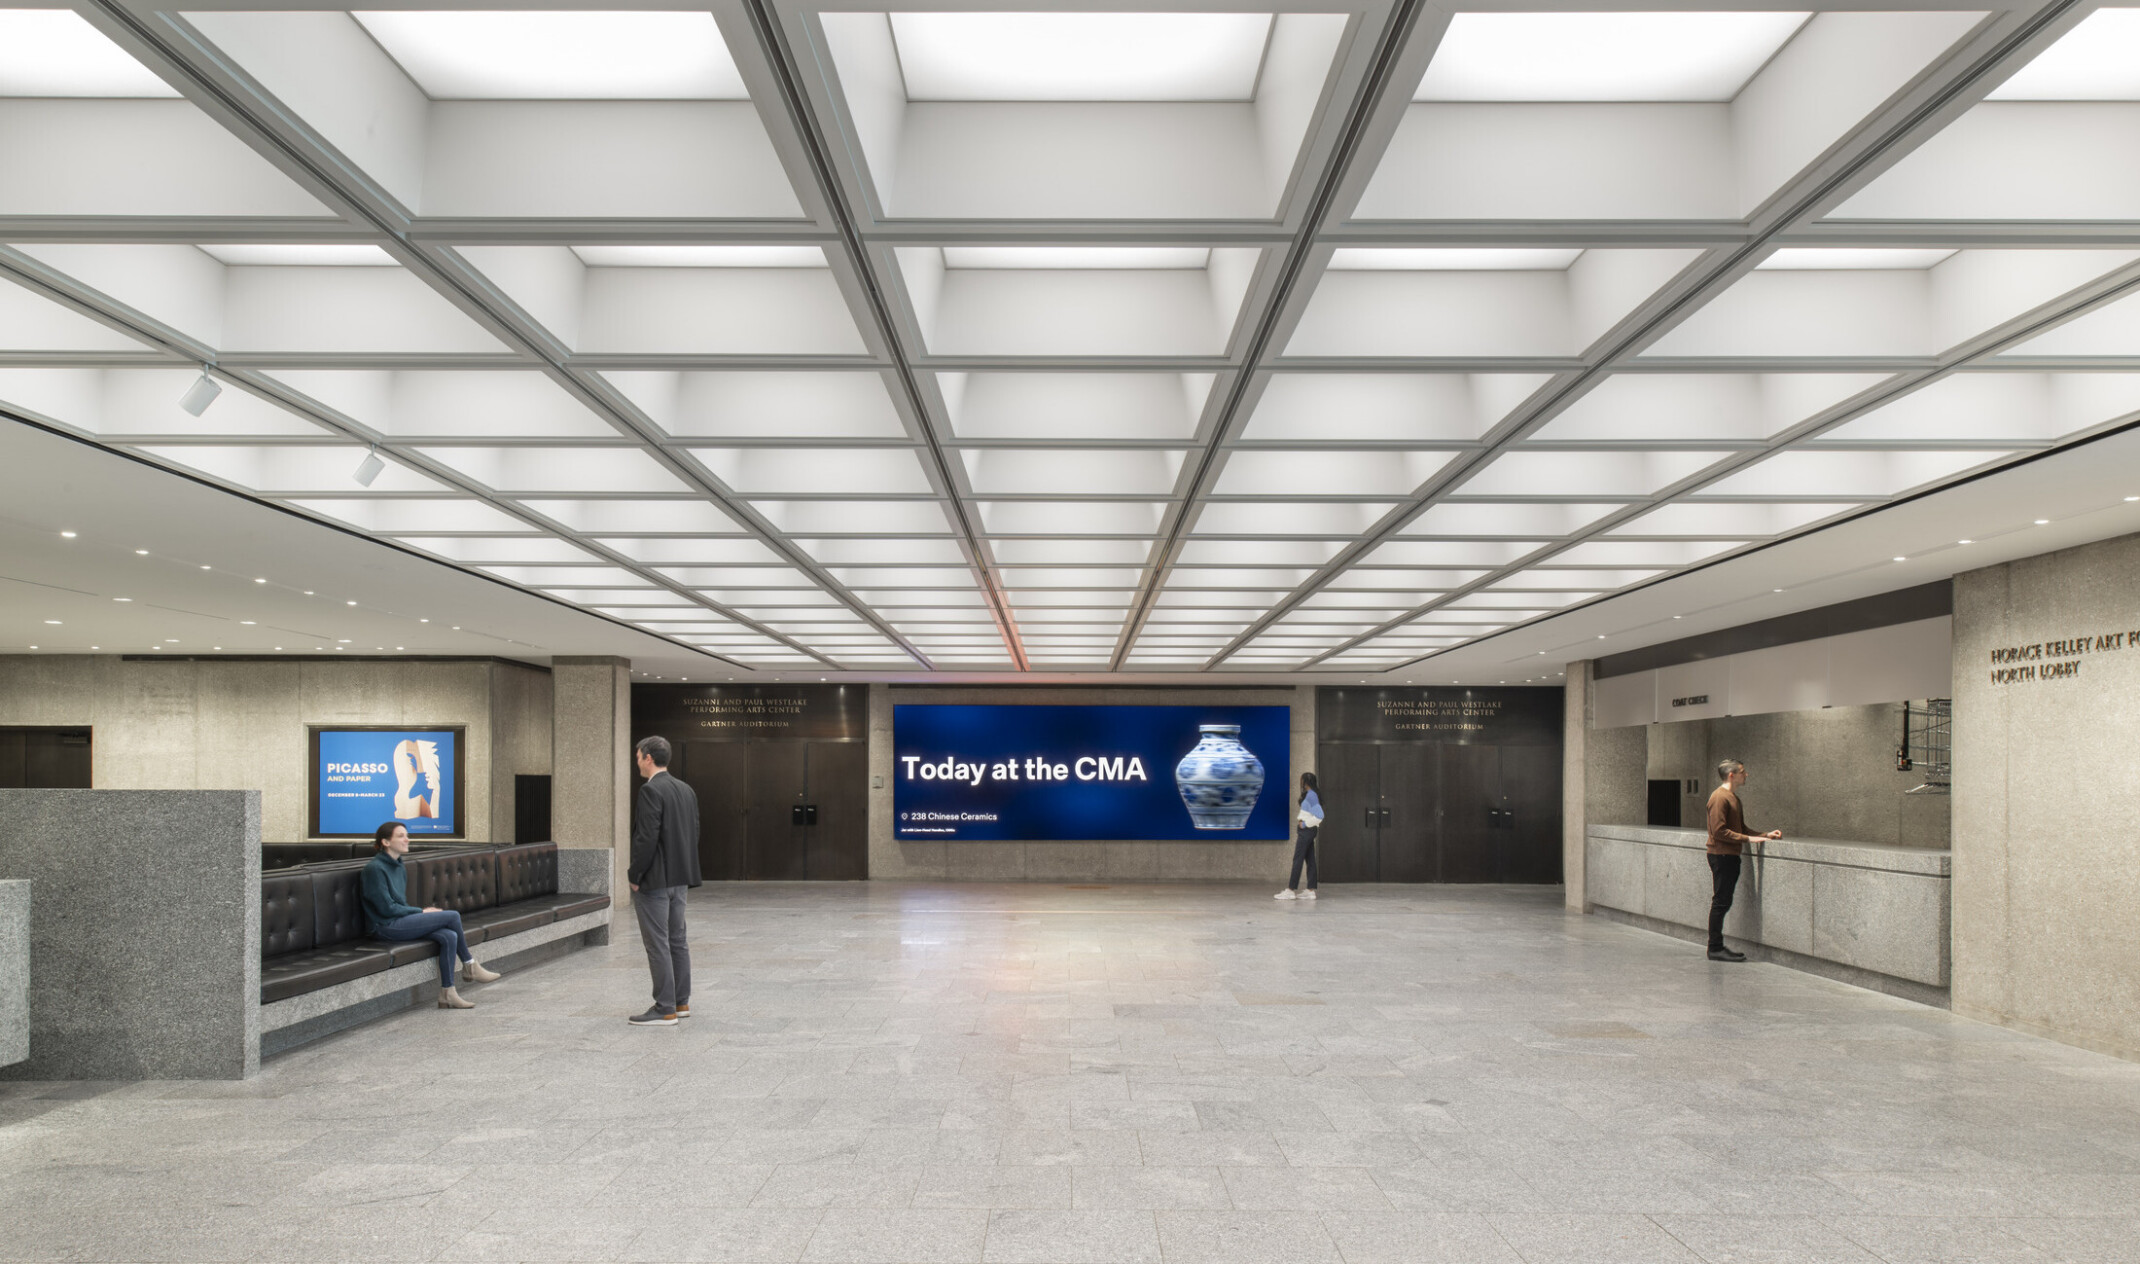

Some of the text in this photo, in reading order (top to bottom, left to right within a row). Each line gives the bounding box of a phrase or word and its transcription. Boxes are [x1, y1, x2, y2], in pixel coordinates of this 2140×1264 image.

[1991, 644, 2041, 663] HORACE
[2045, 637, 2092, 655] KELLEY
[2095, 632, 2124, 649] ART
[1991, 661, 2081, 684] NORTH LOBBY
[1461, 701, 1502, 709] WESTLAKE
[1672, 695, 1709, 707] COAT CHECK
[1385, 708, 1495, 716] PERFORMING ARTS CENTER
[327, 763, 388, 774] PICASSO
[901, 756, 1147, 786] Today at the CMA
[911, 812, 998, 821] 238 Chinese Ceramics
